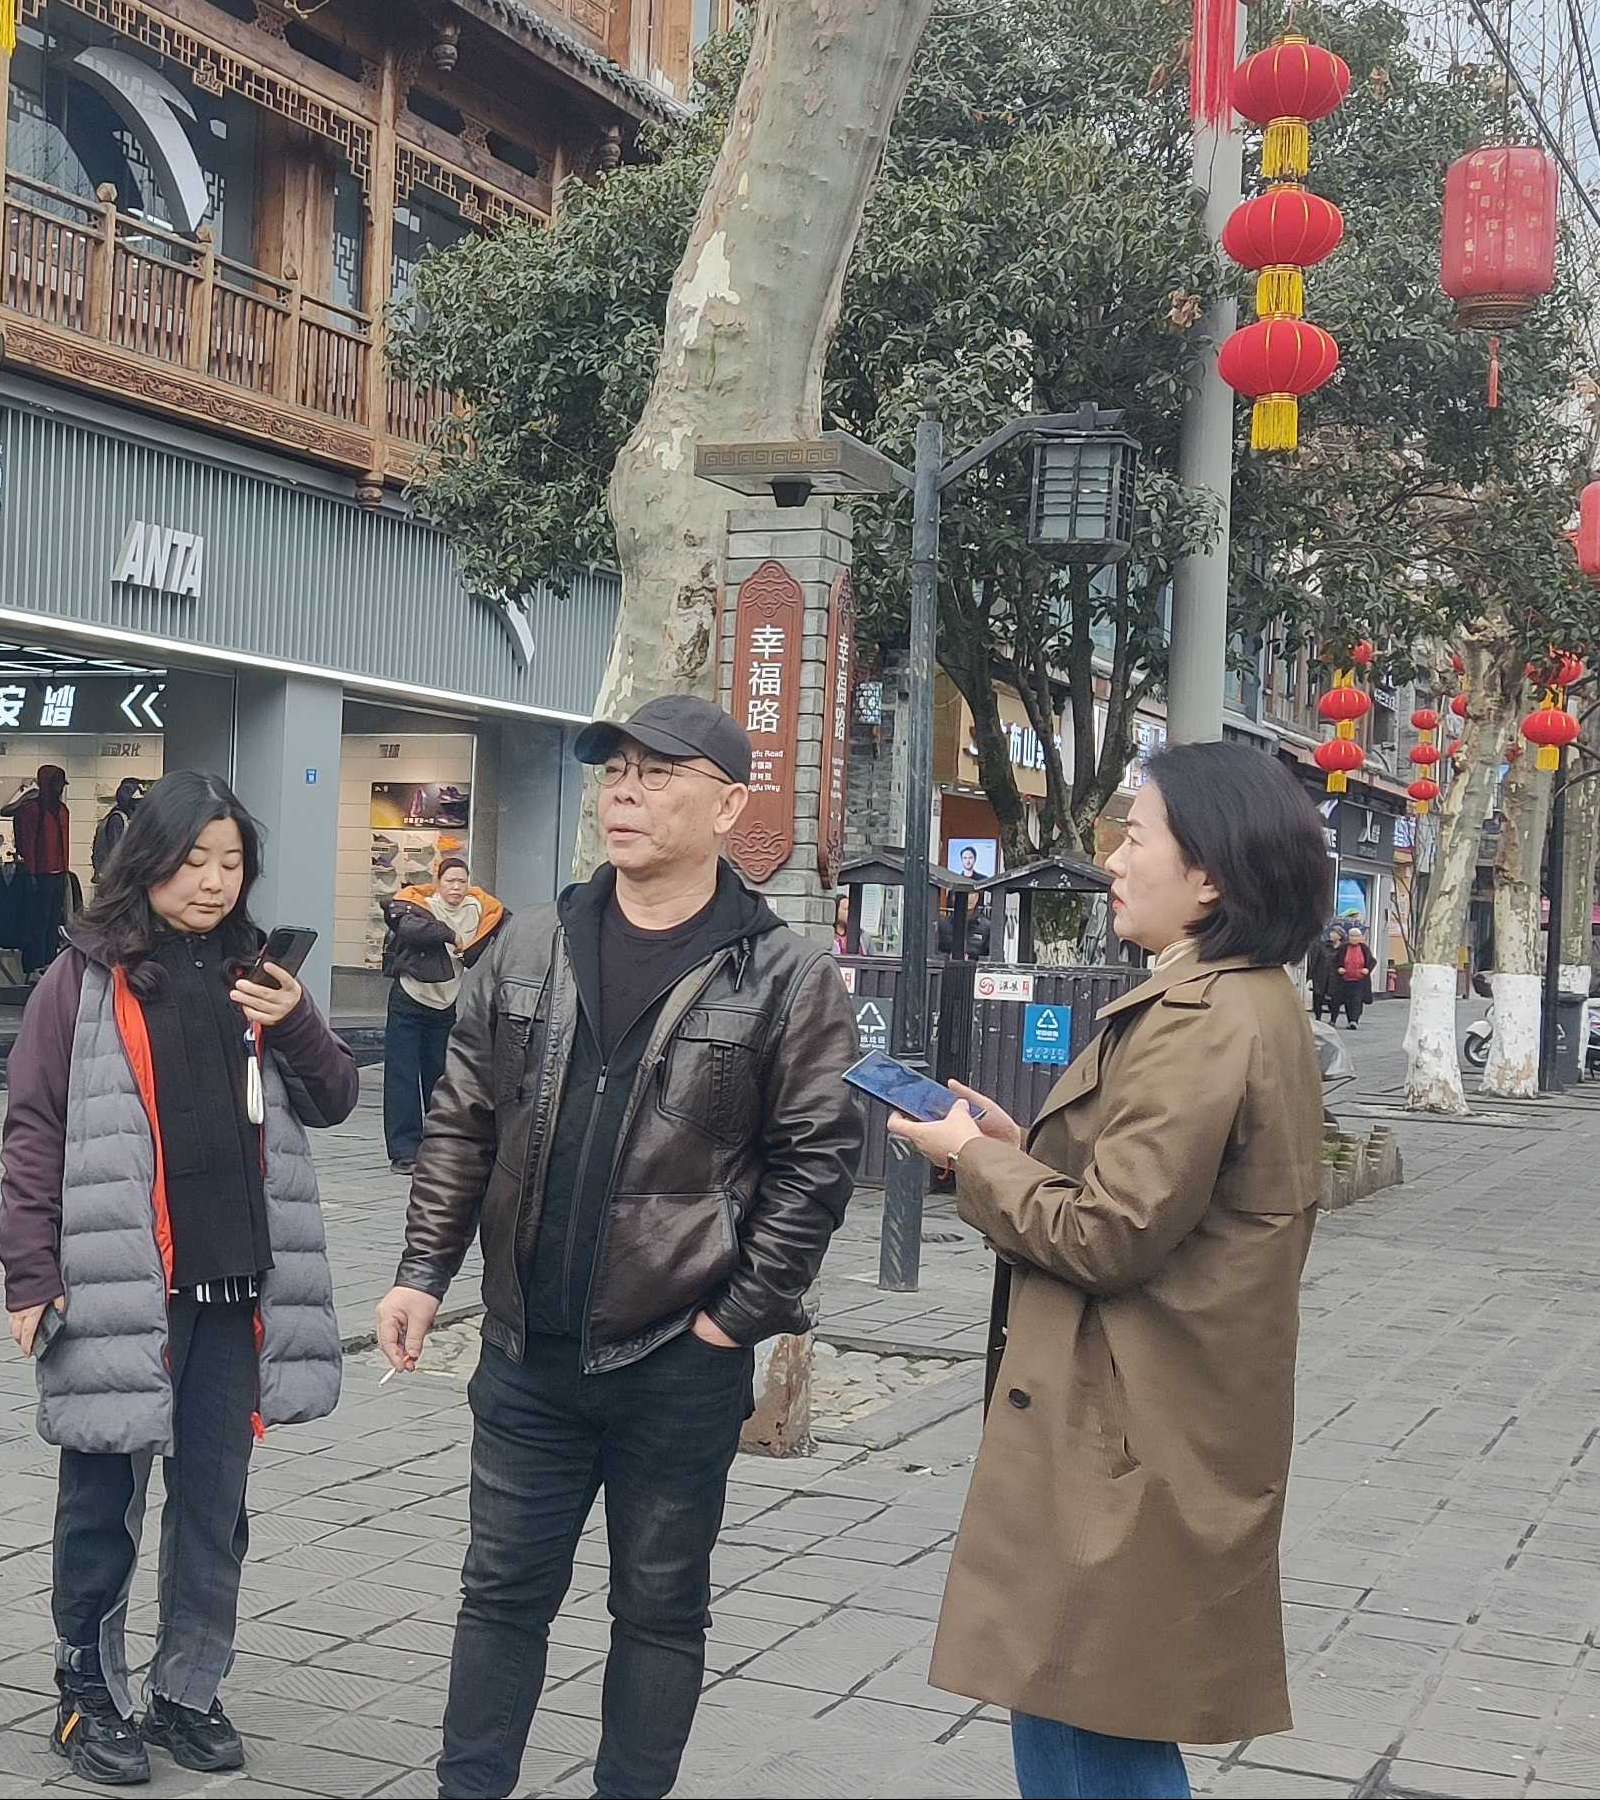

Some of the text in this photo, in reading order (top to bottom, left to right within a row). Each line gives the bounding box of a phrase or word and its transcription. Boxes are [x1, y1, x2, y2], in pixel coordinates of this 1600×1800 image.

[110, 520, 203, 598] ANTA
[747, 624, 785, 734] 幸福路
